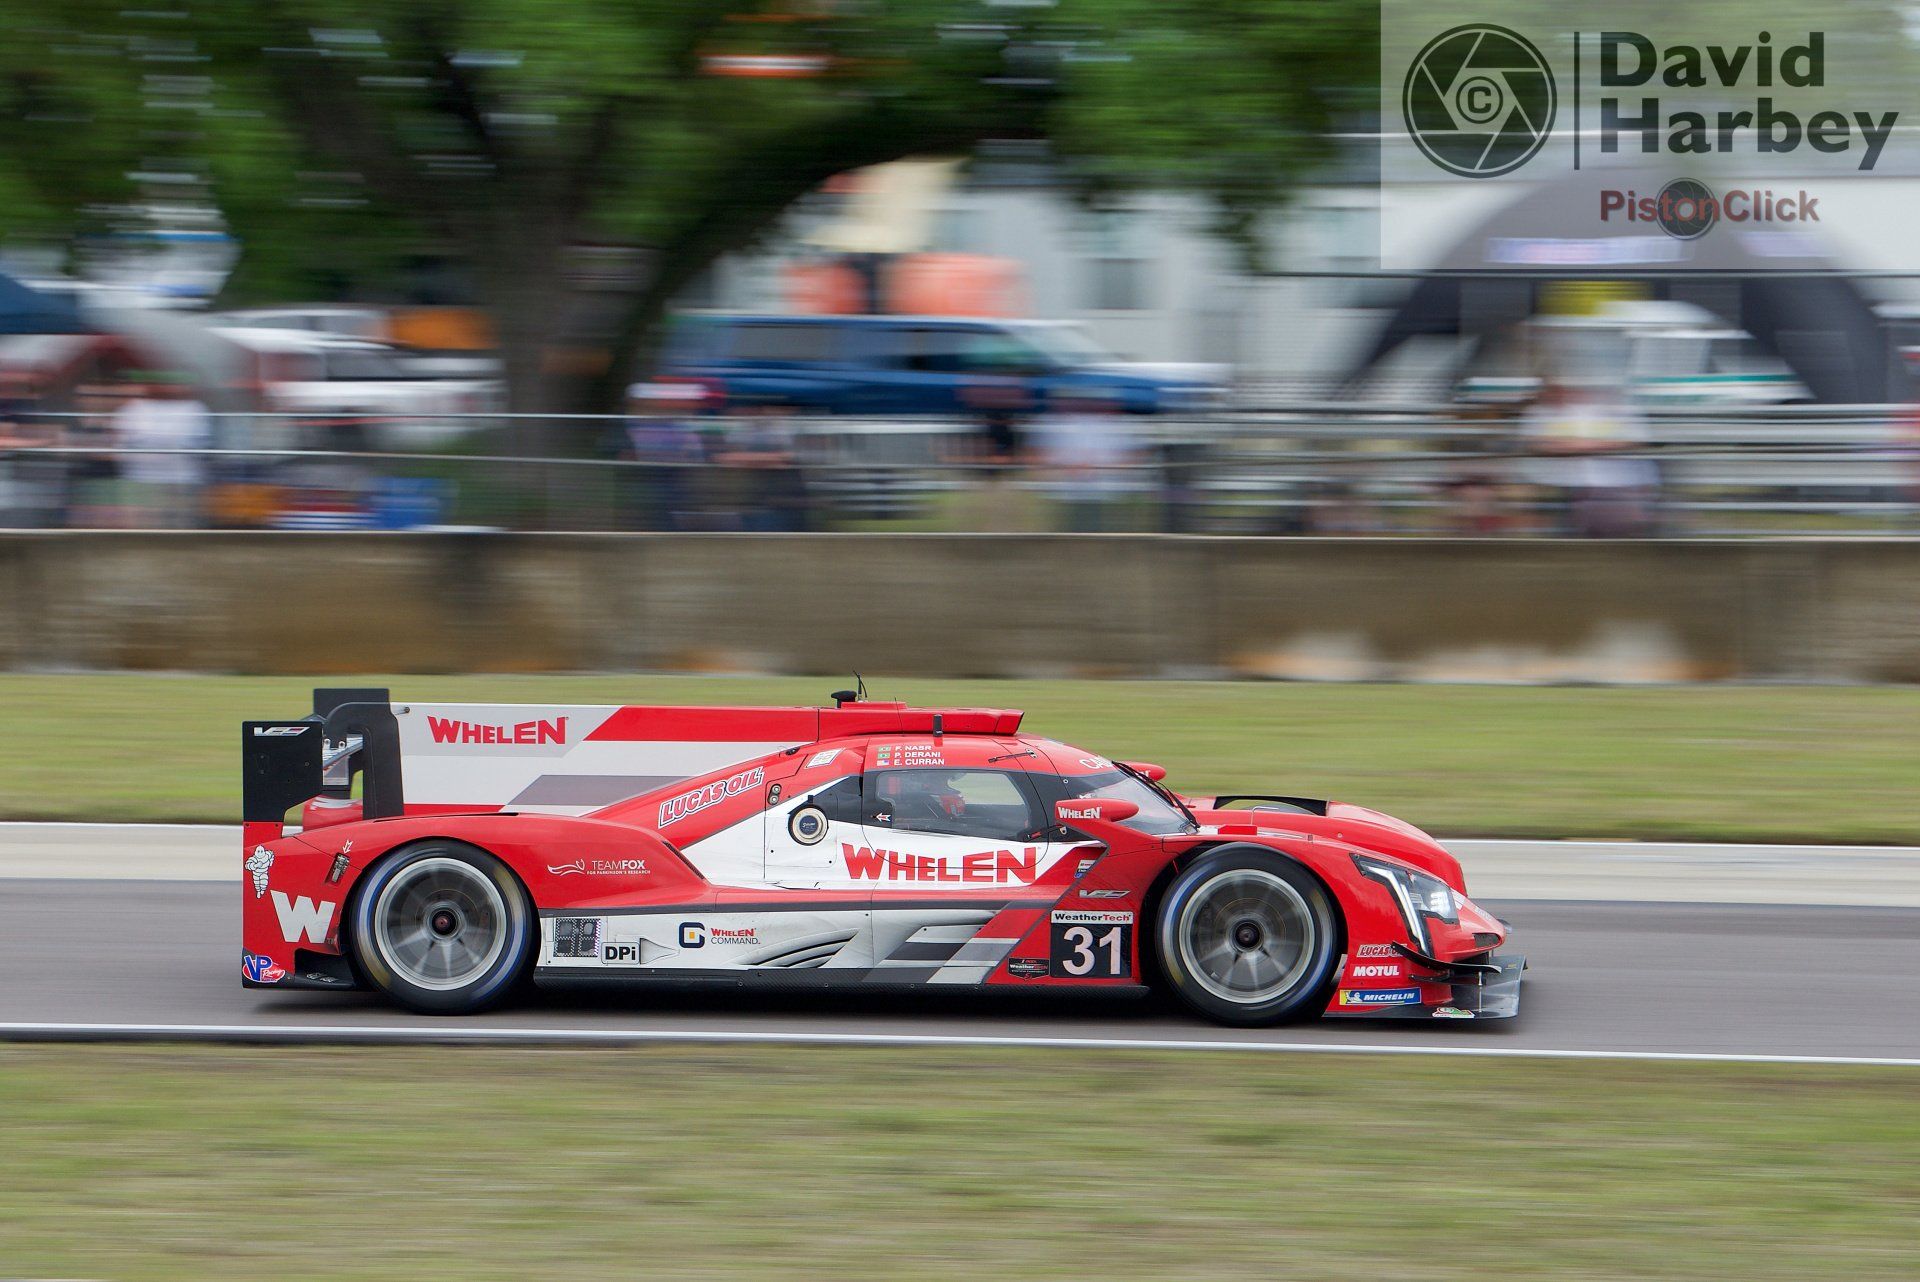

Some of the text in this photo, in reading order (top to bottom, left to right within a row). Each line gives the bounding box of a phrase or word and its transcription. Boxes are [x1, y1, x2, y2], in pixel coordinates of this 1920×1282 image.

[427, 715, 566, 744] WHELEN
[905, 758, 945, 766] CURRAN
[659, 769, 763, 826] LUCAS OIL
[1058, 807, 1101, 819] WHELEN
[842, 843, 1036, 883] WHELEN
[270, 889, 336, 943] W
[1054, 913, 1130, 921] WeatherTech
[711, 928, 755, 937] WHELEN
[605, 946, 636, 960] DPi
[1062, 926, 1121, 976] 31
[244, 955, 273, 982] VP
[1353, 965, 1400, 977] MOTUL
[1363, 992, 1415, 1001] MICHELIN
